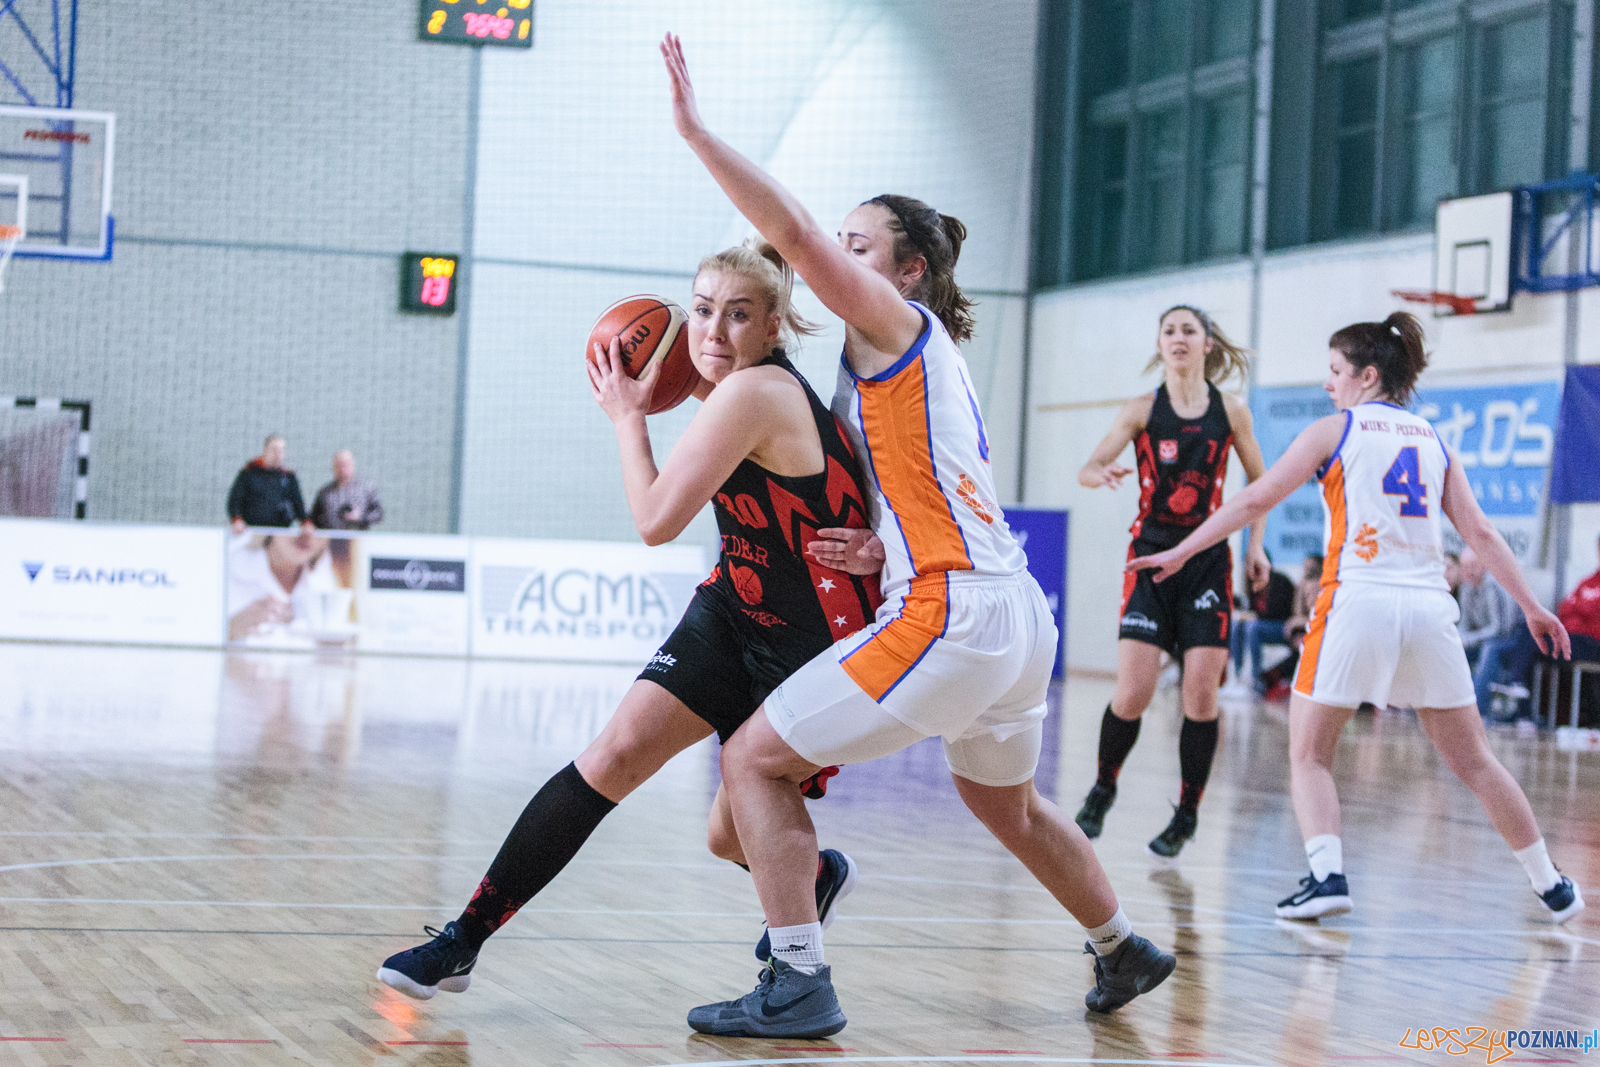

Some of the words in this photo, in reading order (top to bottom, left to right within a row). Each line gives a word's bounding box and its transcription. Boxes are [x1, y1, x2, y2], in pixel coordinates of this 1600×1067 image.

[1360, 420, 1390, 432] MUKS
[1382, 446, 1428, 518] 4
[53, 565, 177, 588] SANPOL
[517, 569, 668, 617] AGMA
